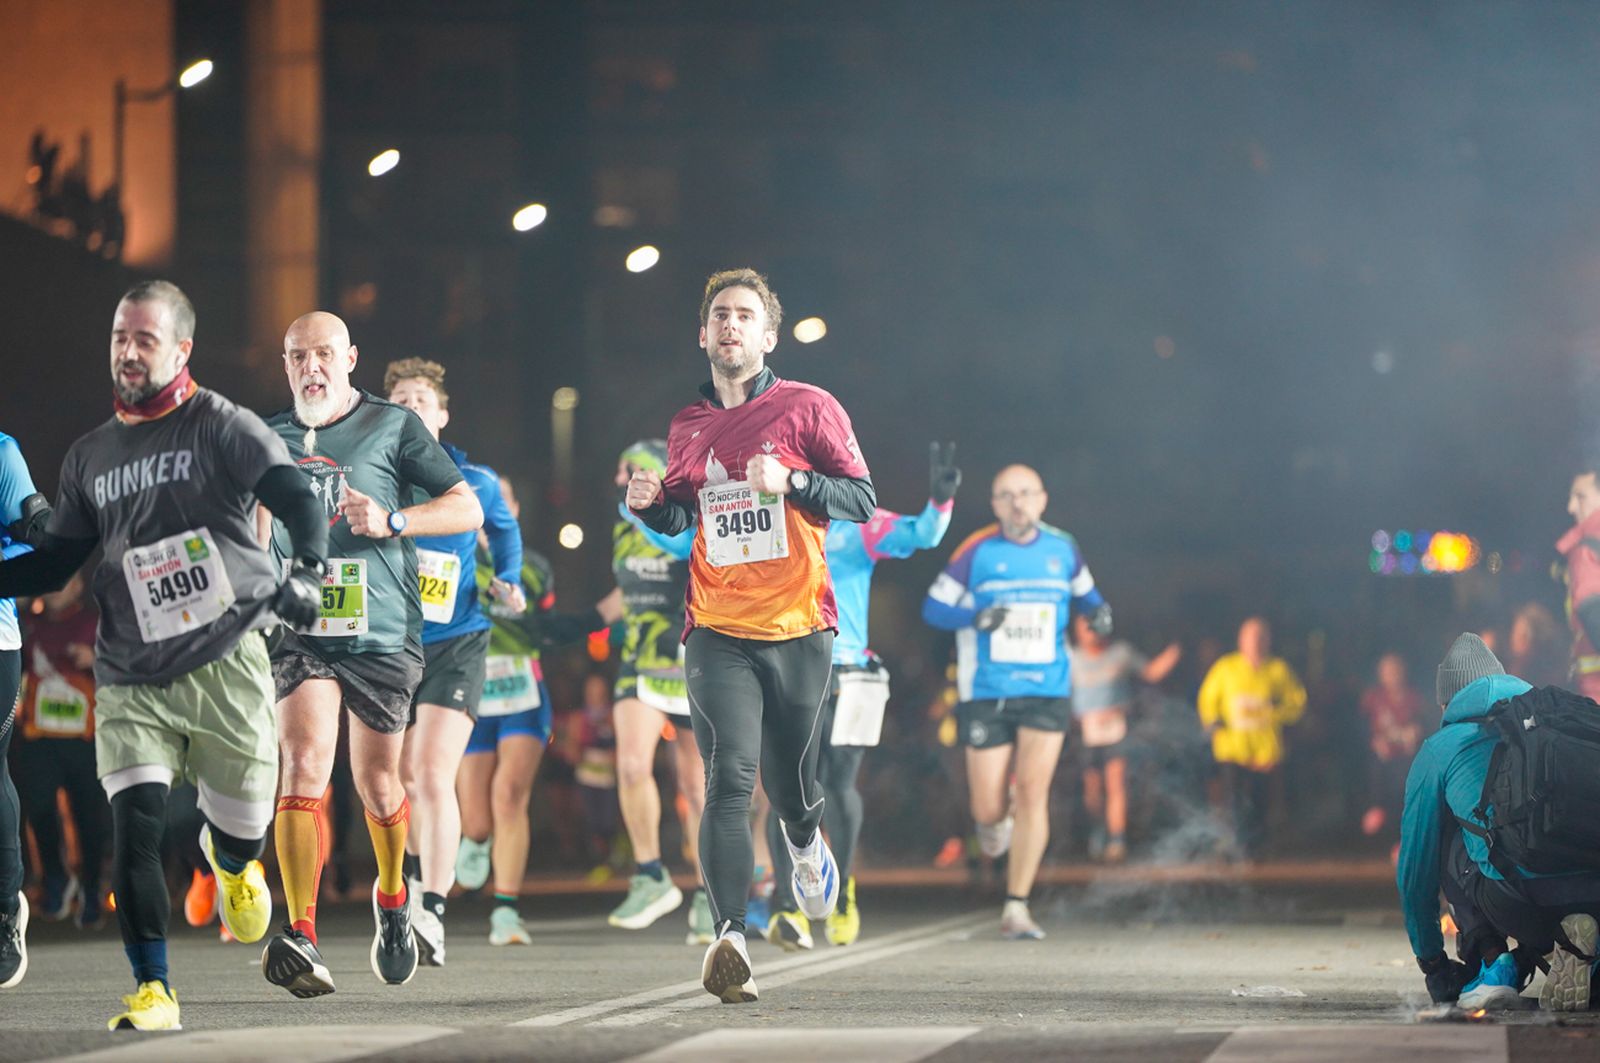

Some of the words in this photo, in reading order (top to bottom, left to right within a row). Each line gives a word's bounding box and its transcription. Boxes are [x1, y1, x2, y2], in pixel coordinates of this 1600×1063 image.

[94, 449, 193, 509] BUNKER
[709, 502, 726, 514] SAN
[717, 492, 741, 502] NOCHE
[742, 490, 752, 499] DE
[716, 508, 772, 538] 3490
[147, 565, 209, 607] 5490
[321, 586, 346, 610] 57
[418, 575, 448, 599] 024
